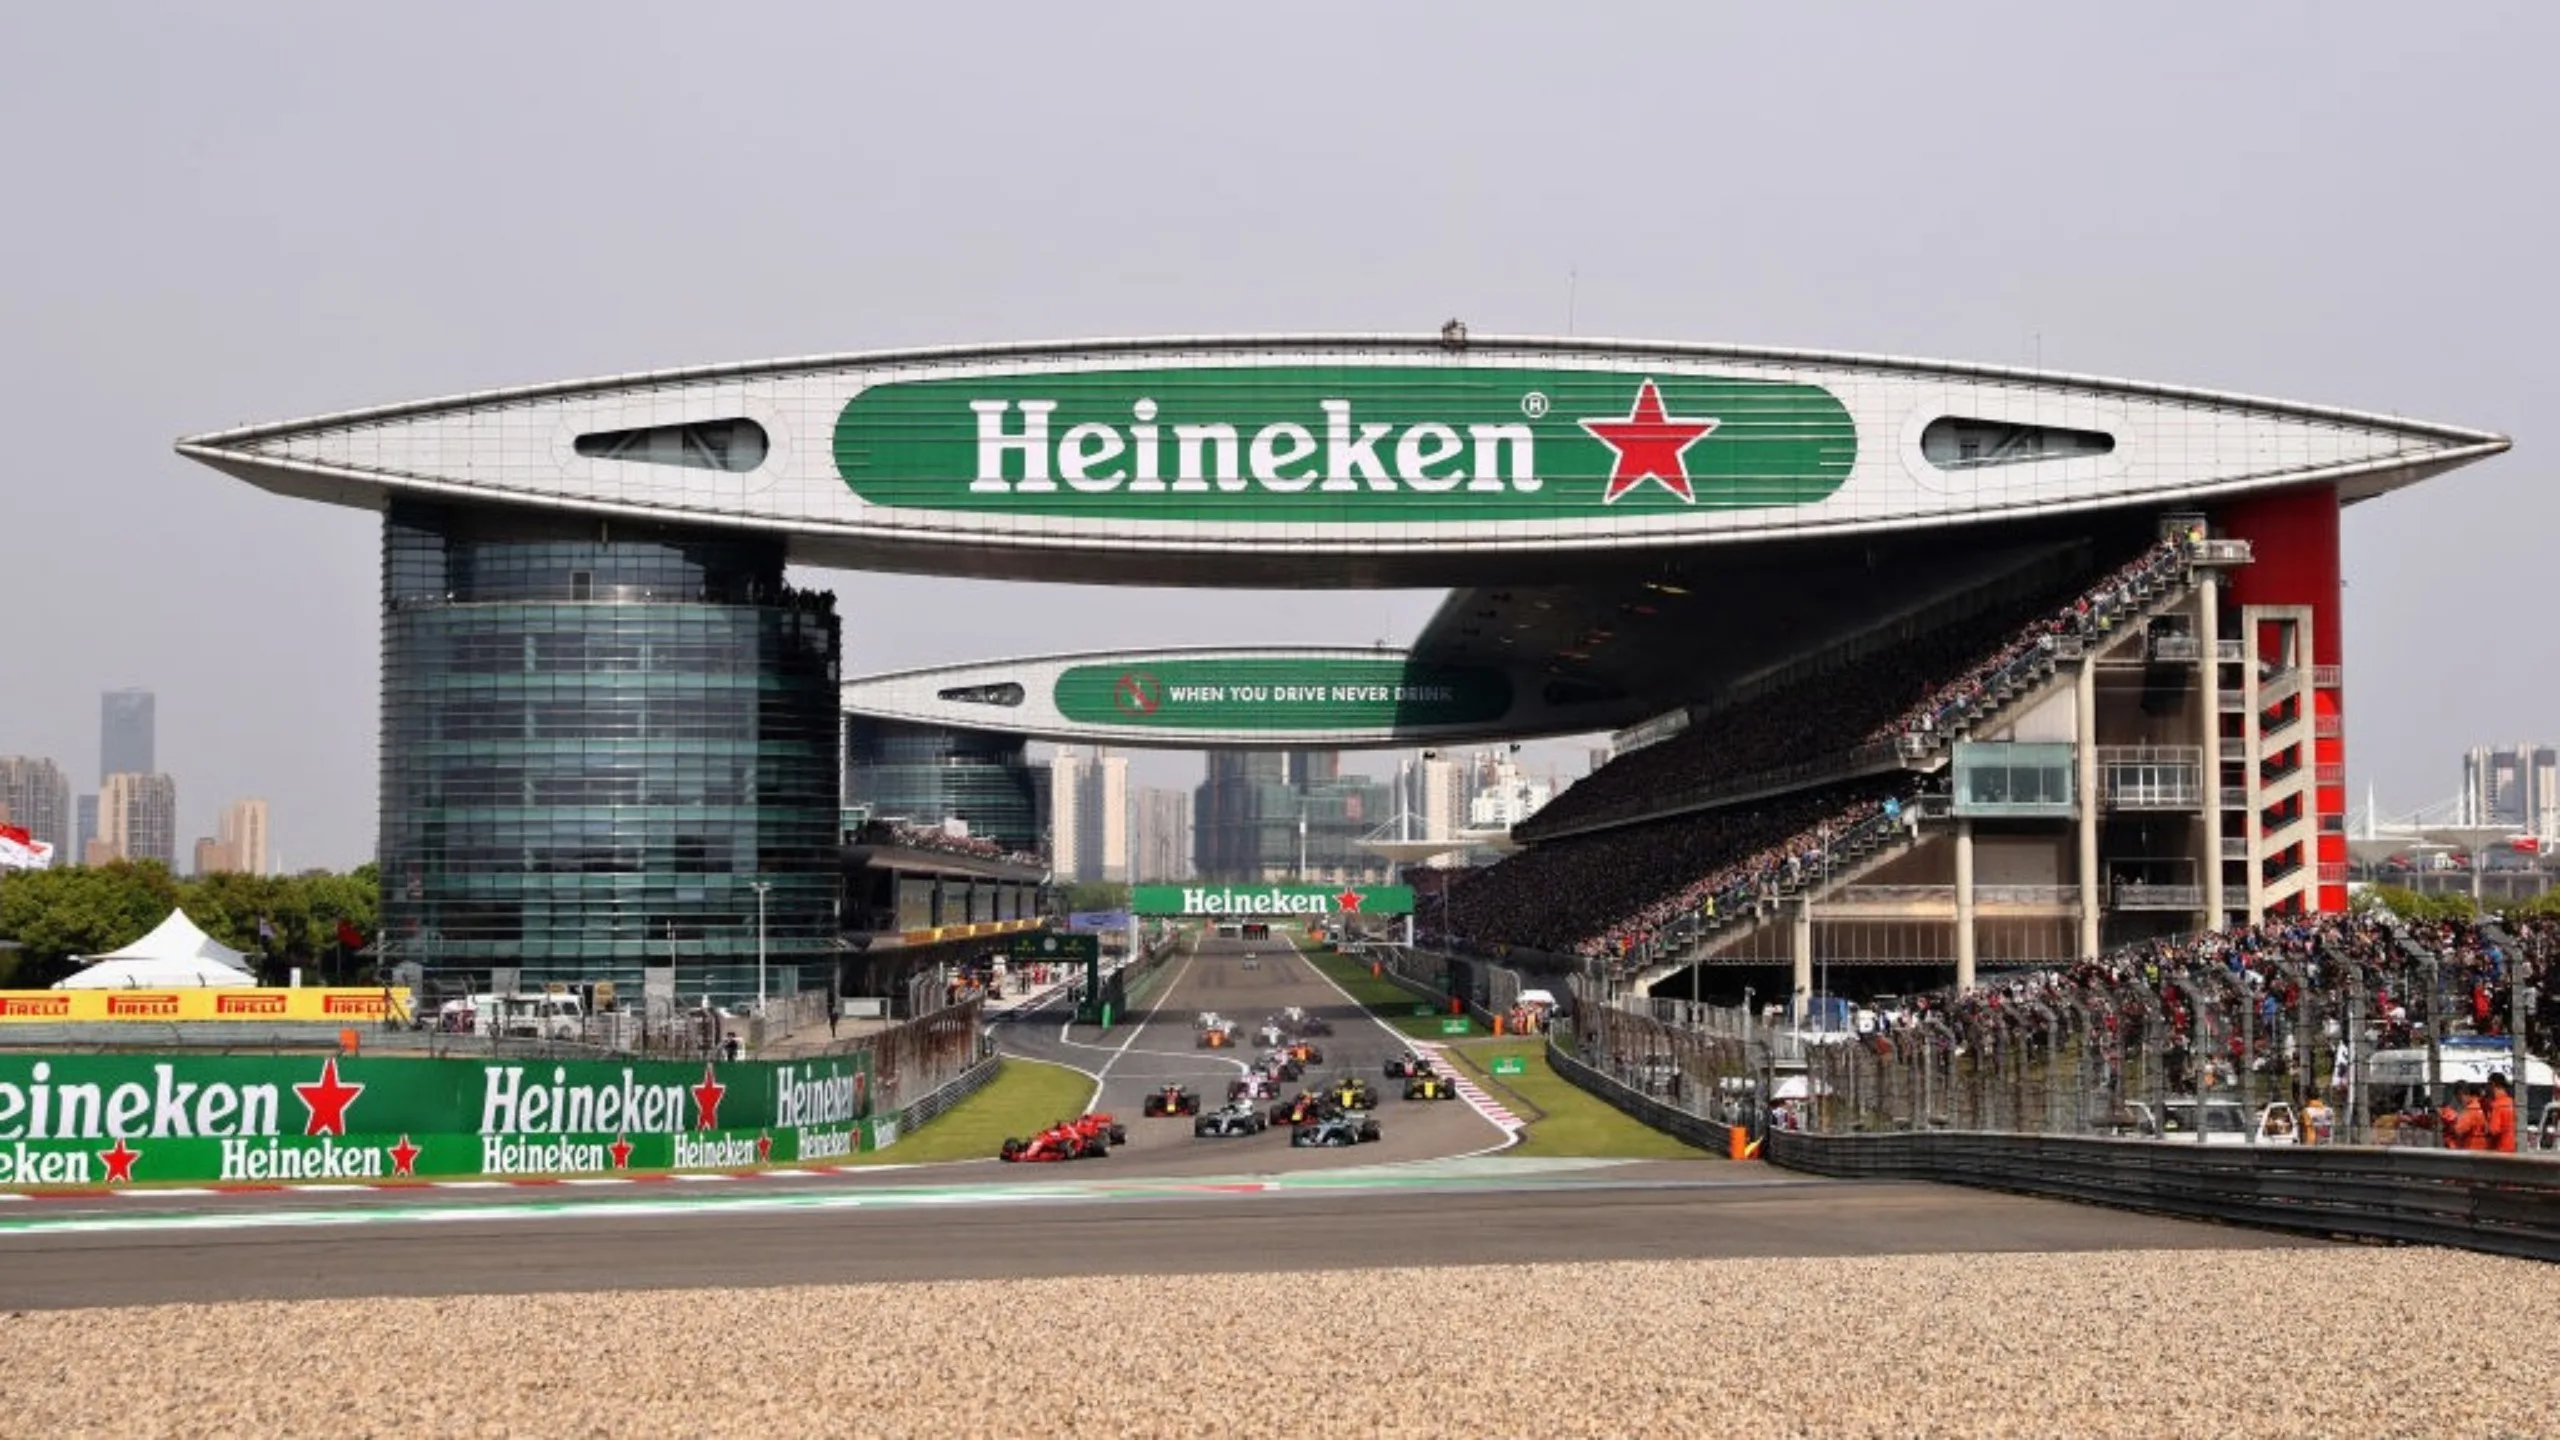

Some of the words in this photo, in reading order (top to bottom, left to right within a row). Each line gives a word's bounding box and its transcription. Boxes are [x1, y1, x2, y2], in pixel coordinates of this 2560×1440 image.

[970, 398, 1543, 493] Heineken
[1169, 686, 1224, 701] WHEN
[1230, 686, 1268, 701] YOU
[1274, 686, 1326, 701] DRIVE
[1332, 686, 1388, 701] NEVER
[1394, 686, 1454, 701] DRINK
[1182, 888, 1328, 914] Heineken
[107, 995, 179, 1015] PIRELLI
[217, 995, 287, 1013] PIRELLI
[480, 1066, 685, 1134] Heineken
[776, 1062, 854, 1127] Heineken
[220, 1139, 382, 1180] Heineken
[482, 1135, 604, 1174] Heineken
[674, 1131, 755, 1168] Heineken
